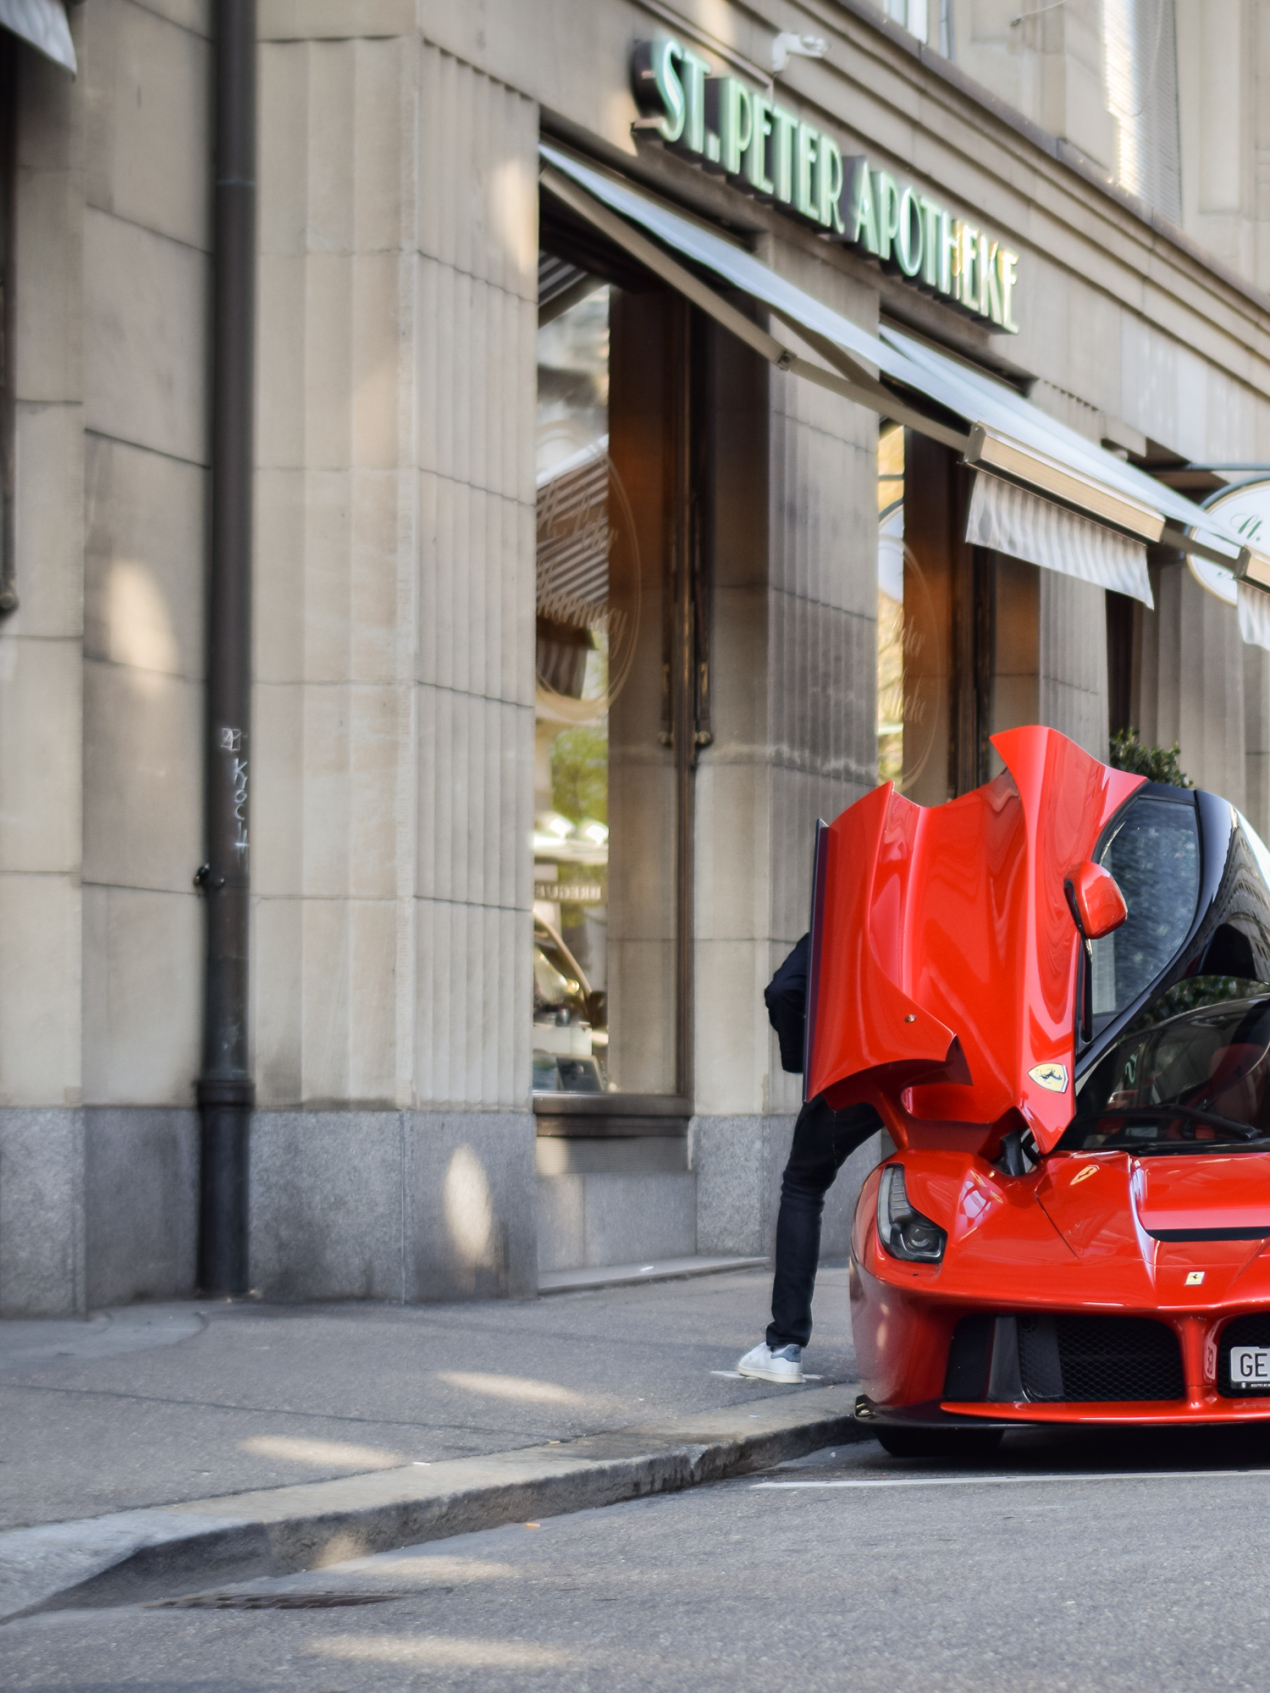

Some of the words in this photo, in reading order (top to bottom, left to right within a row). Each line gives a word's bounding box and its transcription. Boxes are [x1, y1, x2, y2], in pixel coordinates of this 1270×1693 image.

[653, 37, 720, 163] ST.
[719, 77, 845, 234] PETER
[853, 158, 1020, 335] APOTHEKE
[1229, 513, 1262, 542] St.
[1240, 1352, 1268, 1377] GE
